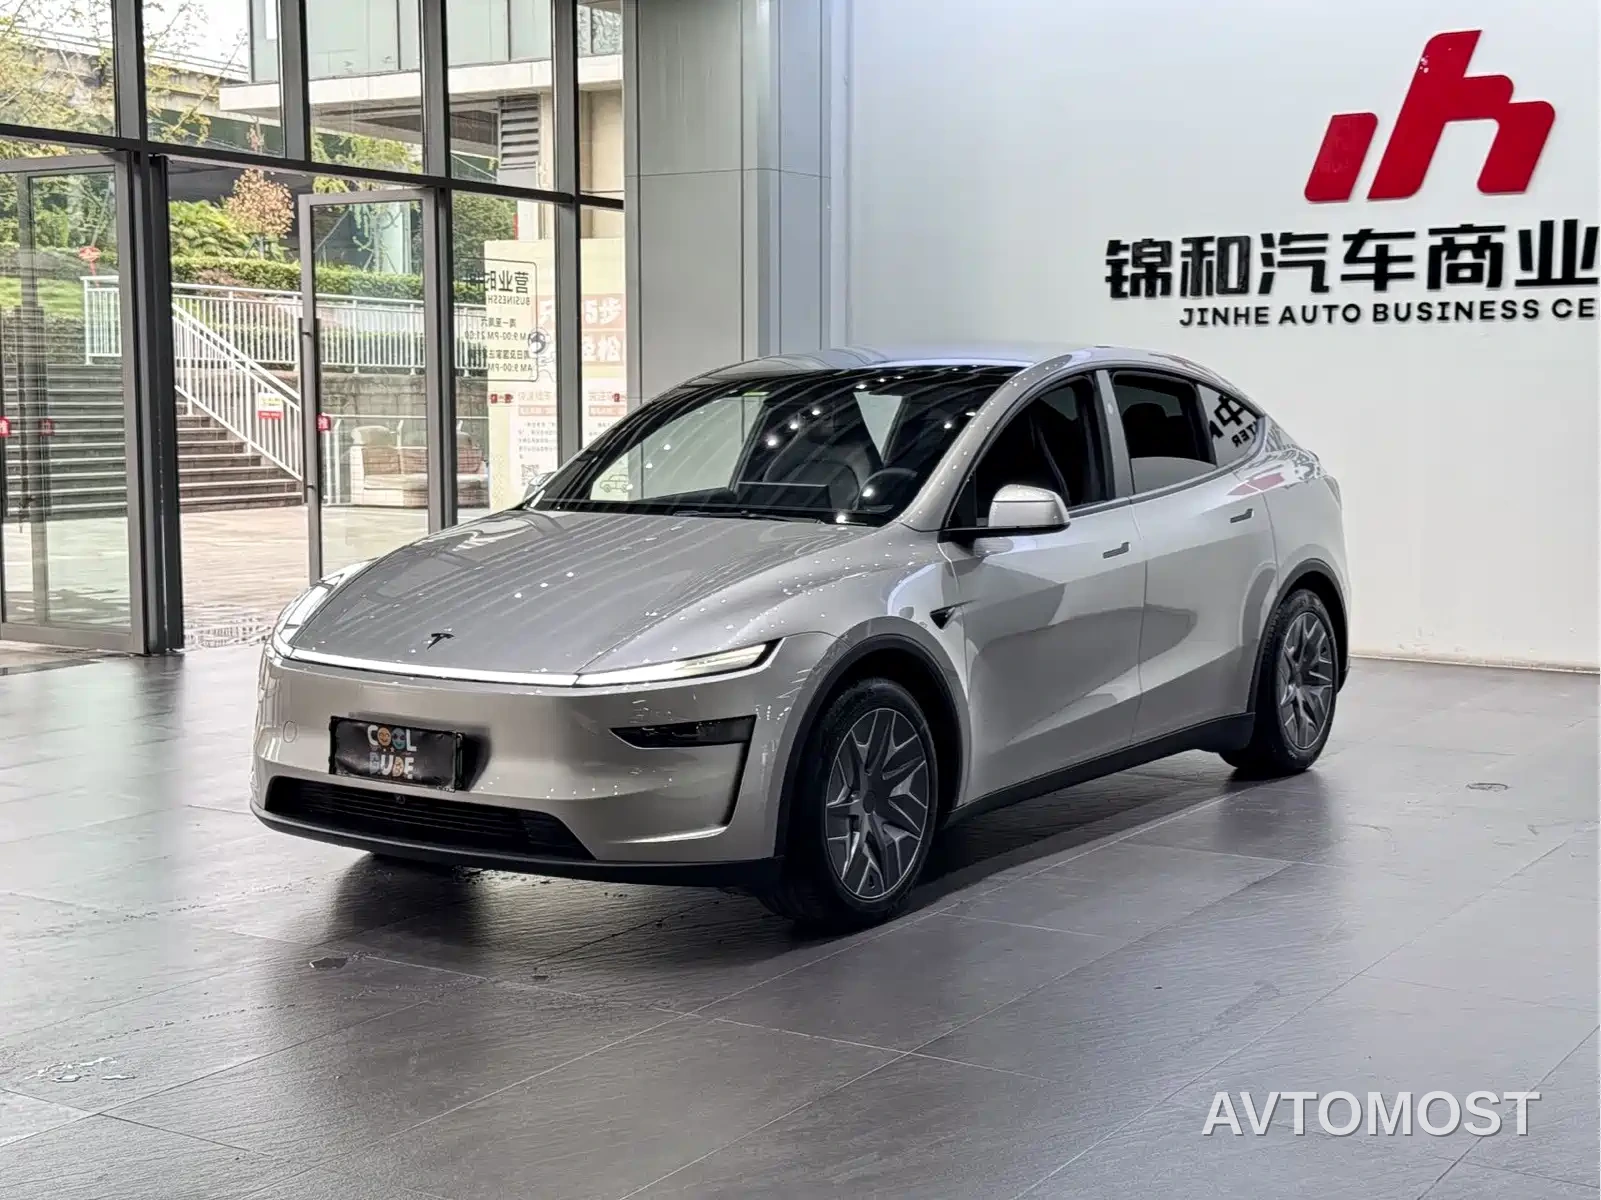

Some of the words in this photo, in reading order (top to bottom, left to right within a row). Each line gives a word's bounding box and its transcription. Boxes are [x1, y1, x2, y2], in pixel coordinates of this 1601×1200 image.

[1104, 218, 1600, 299] 锦和汽车商业
[1180, 306, 1270, 326] JINHE
[1278, 303, 1362, 325] AUTO
[1372, 299, 1541, 322] BUSINESS
